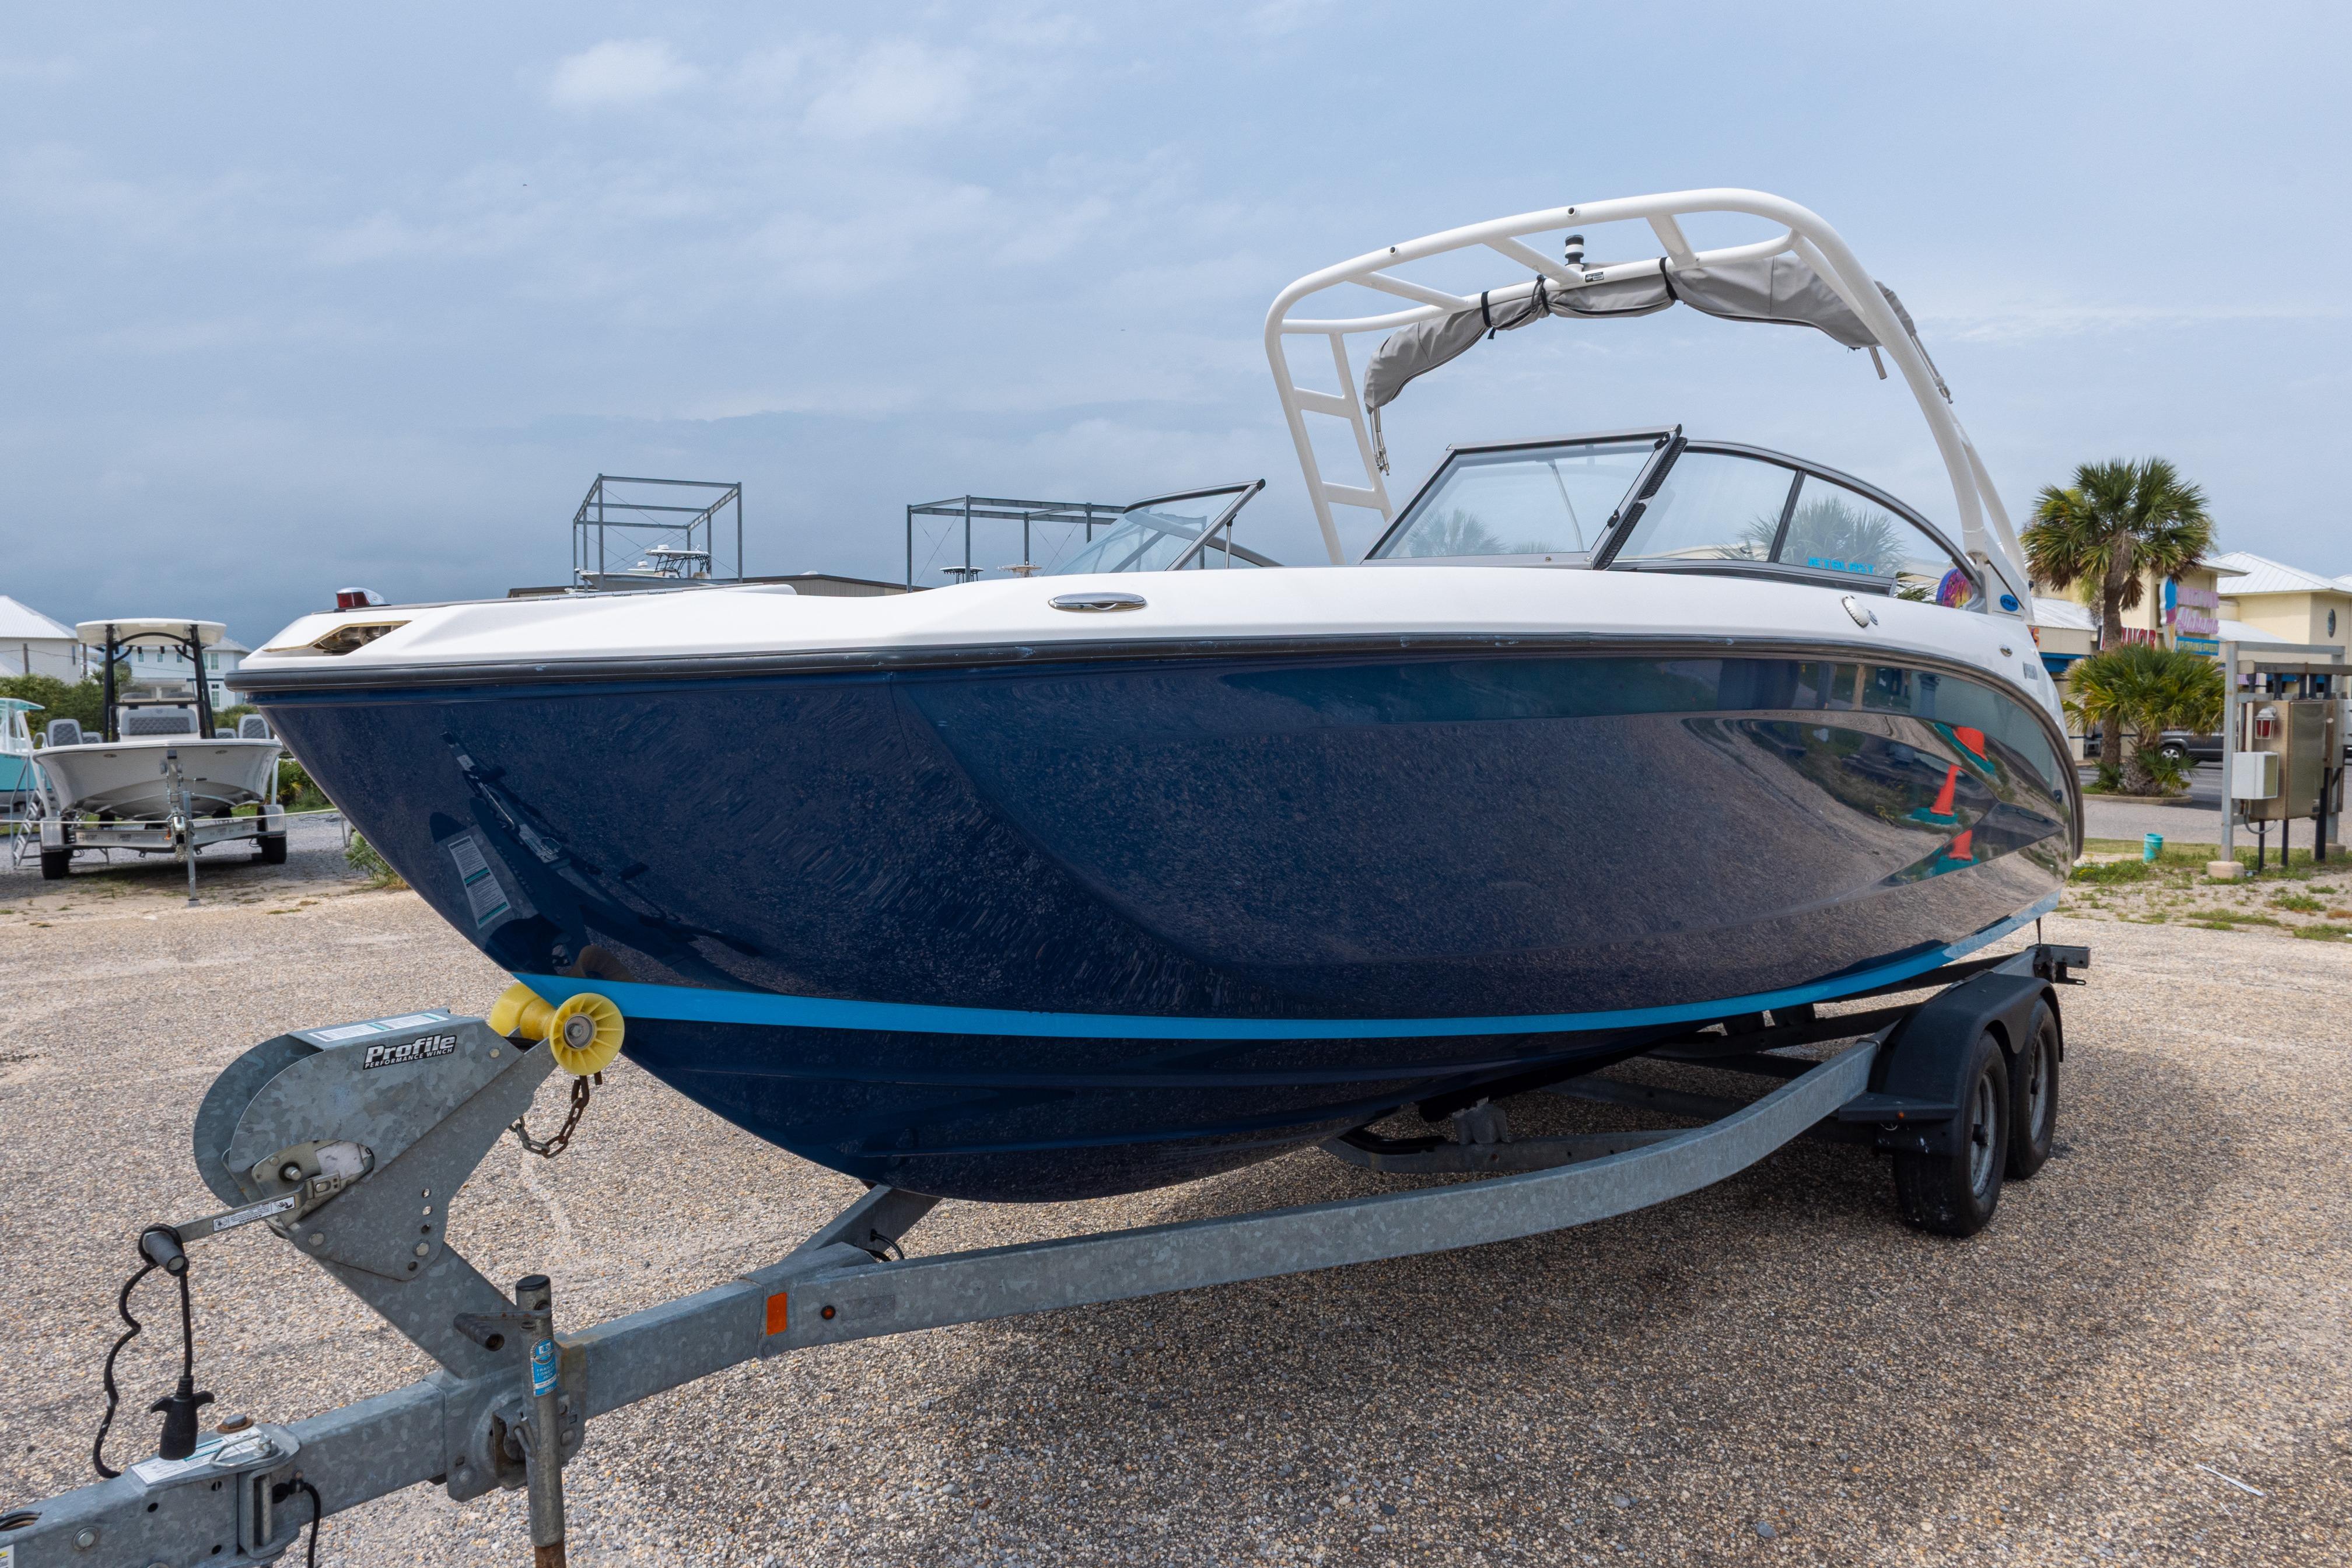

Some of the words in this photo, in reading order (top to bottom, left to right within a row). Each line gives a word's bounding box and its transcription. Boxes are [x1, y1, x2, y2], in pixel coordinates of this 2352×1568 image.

[1808, 556, 1875, 574] JETBLAST
[365, 1034, 456, 1063] Profile
[365, 1052, 424, 1069] PERFORMANCE
[426, 1047, 453, 1058] WINCH
